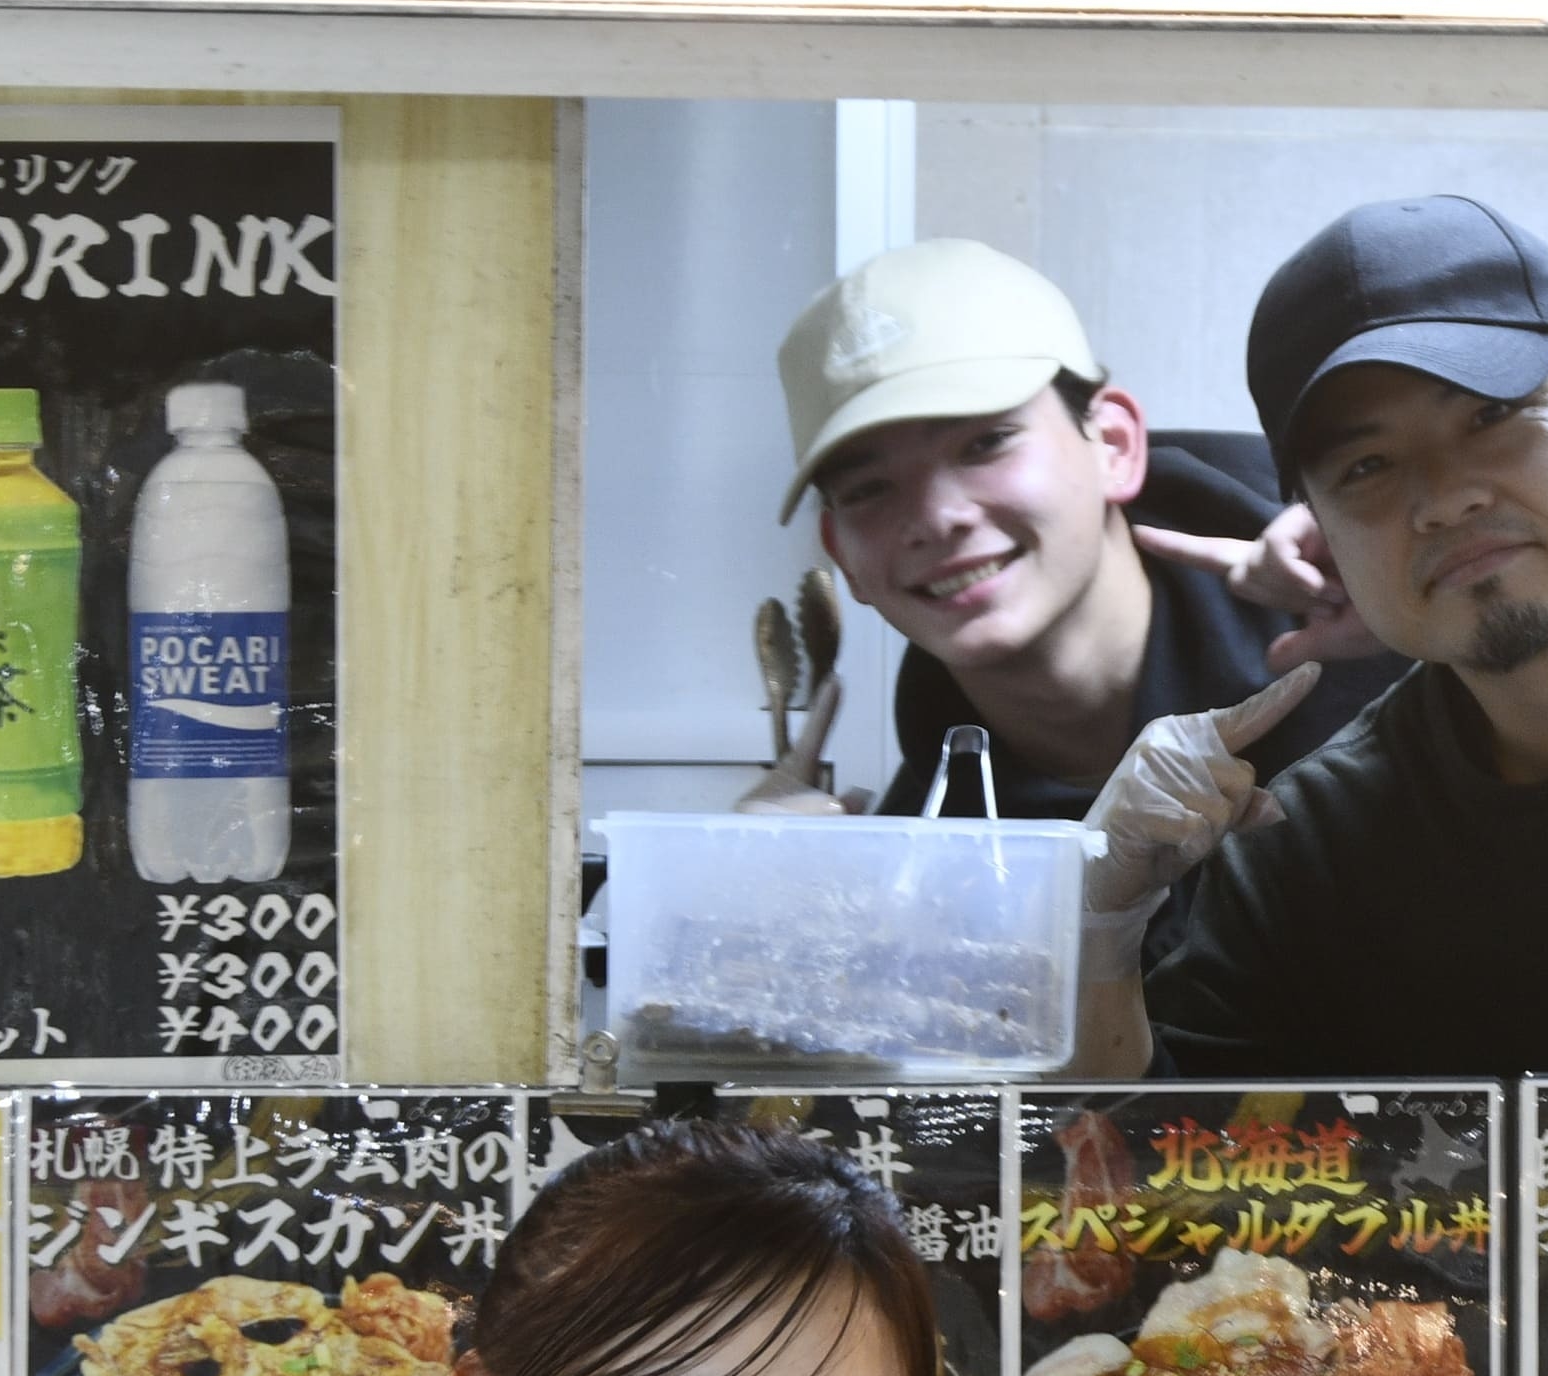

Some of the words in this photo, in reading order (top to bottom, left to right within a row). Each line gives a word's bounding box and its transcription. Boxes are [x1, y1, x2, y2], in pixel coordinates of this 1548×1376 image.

[139, 636, 280, 665] POCARI
[140, 665, 271, 695] SWEAT
[157, 892, 337, 942] ¥300
[157, 950, 337, 1001] ¥300
[157, 1005, 337, 1054] ¥400
[30, 1125, 141, 1181] 札幌
[1148, 1117, 1368, 1196] 北海道
[29, 1195, 503, 1269] ジンギスカン丼
[1020, 1197, 1491, 1256] スペシャルダブル丼
